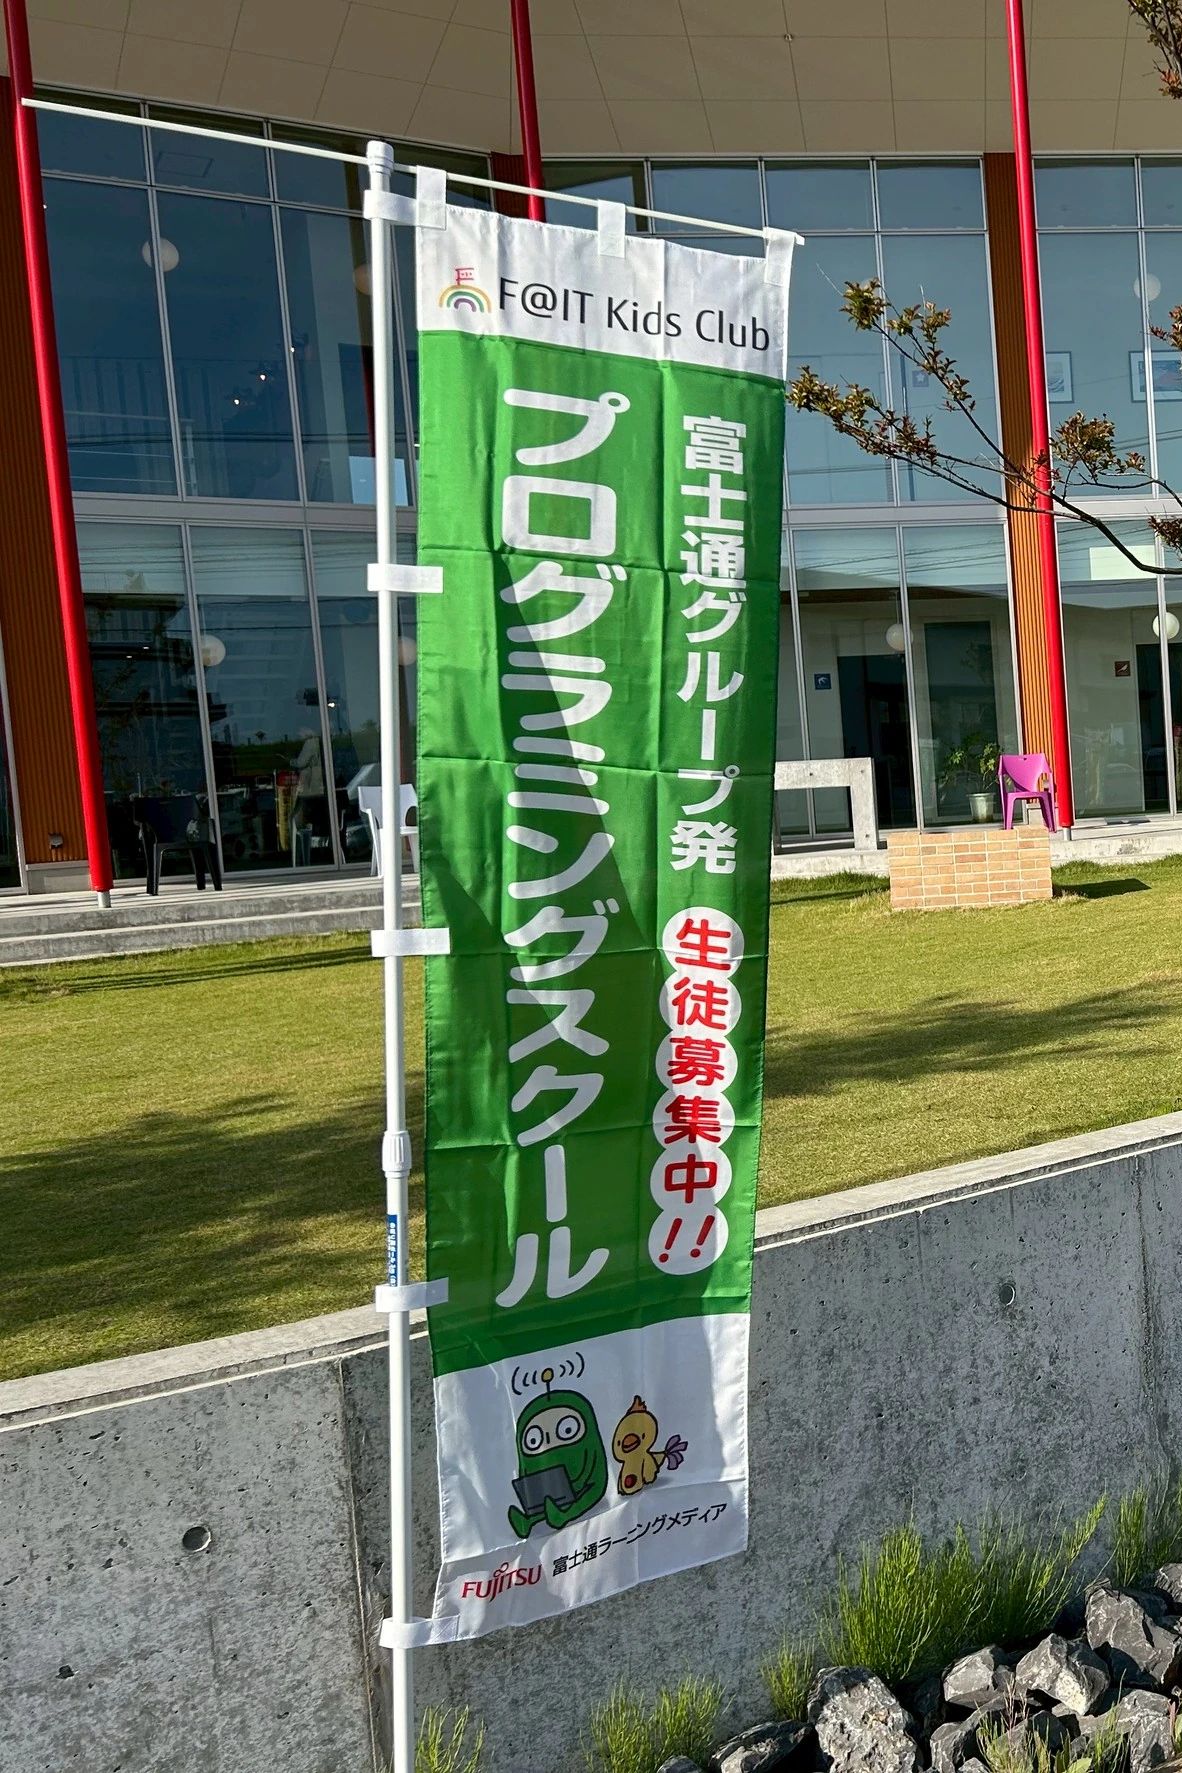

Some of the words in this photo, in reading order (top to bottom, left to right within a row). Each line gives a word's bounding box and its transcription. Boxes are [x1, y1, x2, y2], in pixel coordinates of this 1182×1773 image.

[499, 276, 594, 324] F@IT
[607, 296, 682, 337] Kids
[695, 309, 770, 351] Club
[670, 415, 748, 874] 富士通グループ発
[495, 388, 631, 1308] プログラミングスクール
[461, 1562, 542, 1603] FUJITSU
[552, 1503, 728, 1577] 富士通ラーニングメディア
